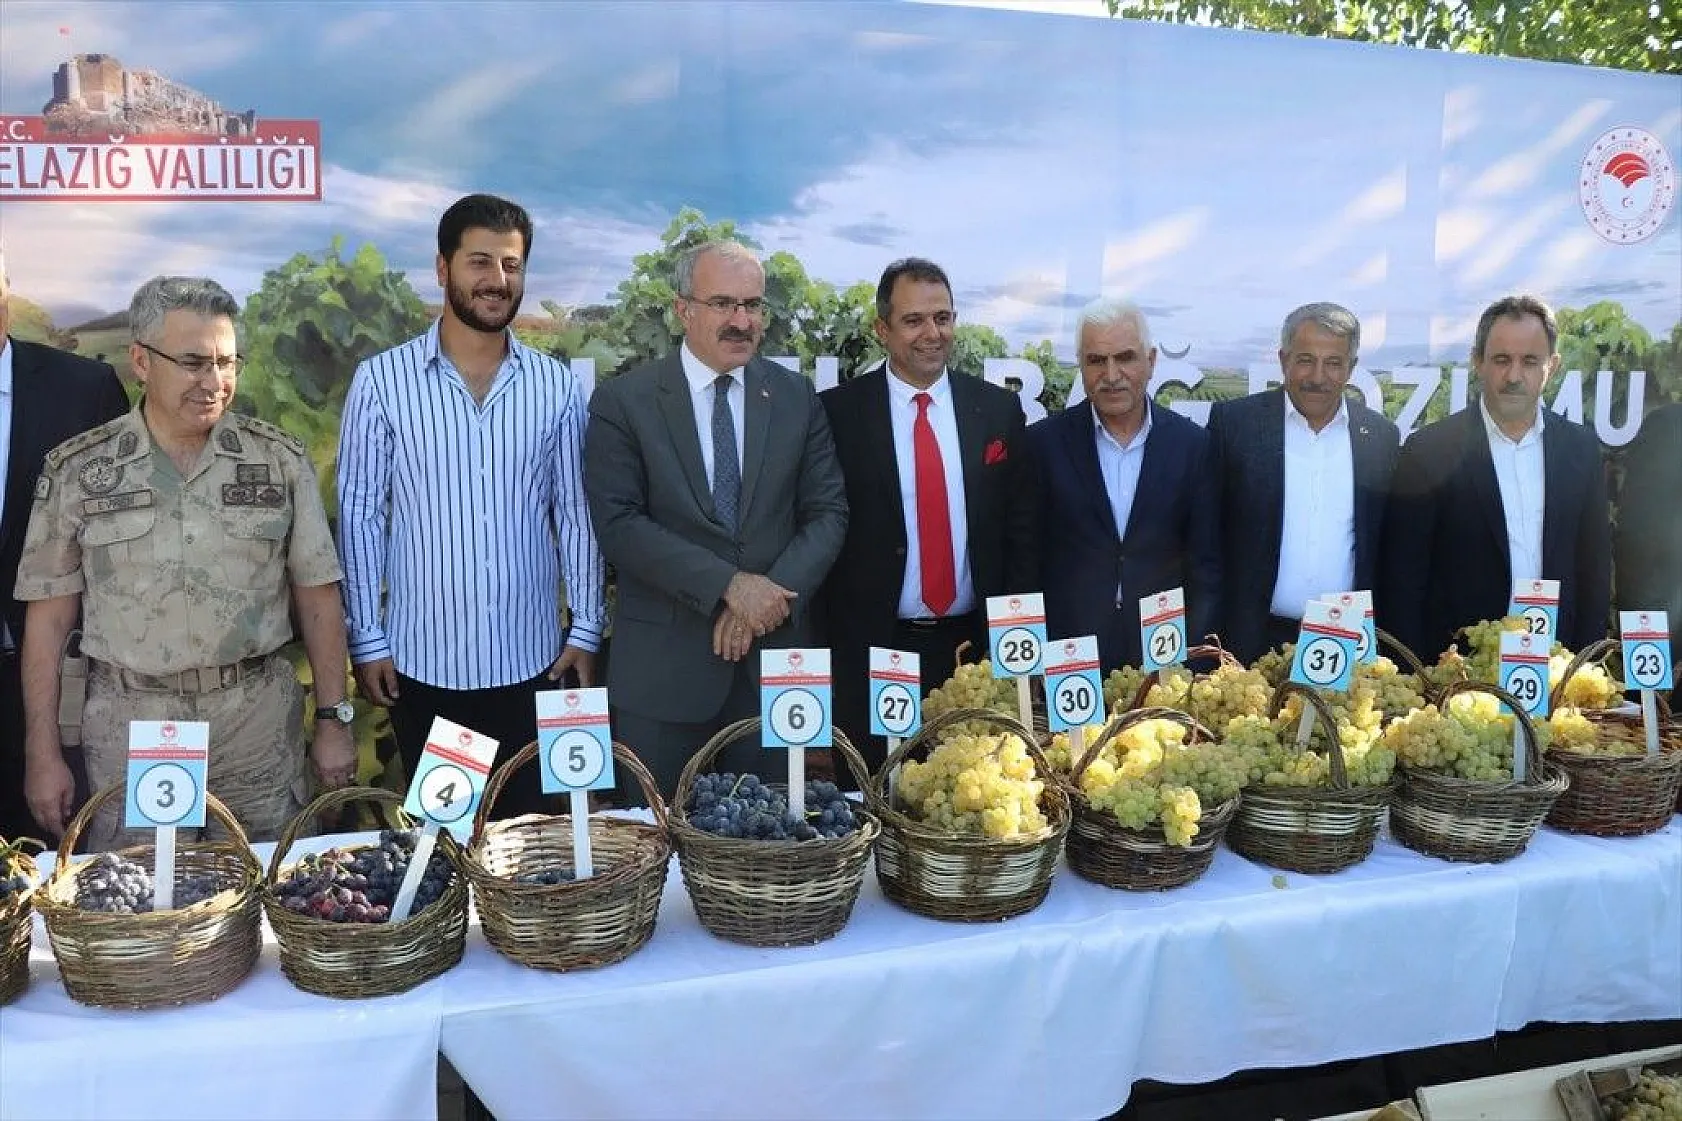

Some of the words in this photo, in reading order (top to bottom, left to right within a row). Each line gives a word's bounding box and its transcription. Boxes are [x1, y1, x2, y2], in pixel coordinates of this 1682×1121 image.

[0, 120, 33, 140] .C.
[0, 134, 133, 189] ELAZIĞ
[144, 136, 306, 189] VALİLİĞİ
[983, 341, 1213, 429] BĞ
[1004, 639, 1035, 663] 28
[1155, 632, 1176, 656] 21
[1309, 648, 1340, 674] 31
[1635, 654, 1660, 676] 23
[1060, 687, 1090, 713] 30
[1512, 677, 1538, 700] 29
[787, 703, 805, 730] 6
[883, 696, 910, 720] 27
[568, 744, 587, 773] 5
[156, 780, 176, 808] 3
[435, 782, 457, 808] 4
